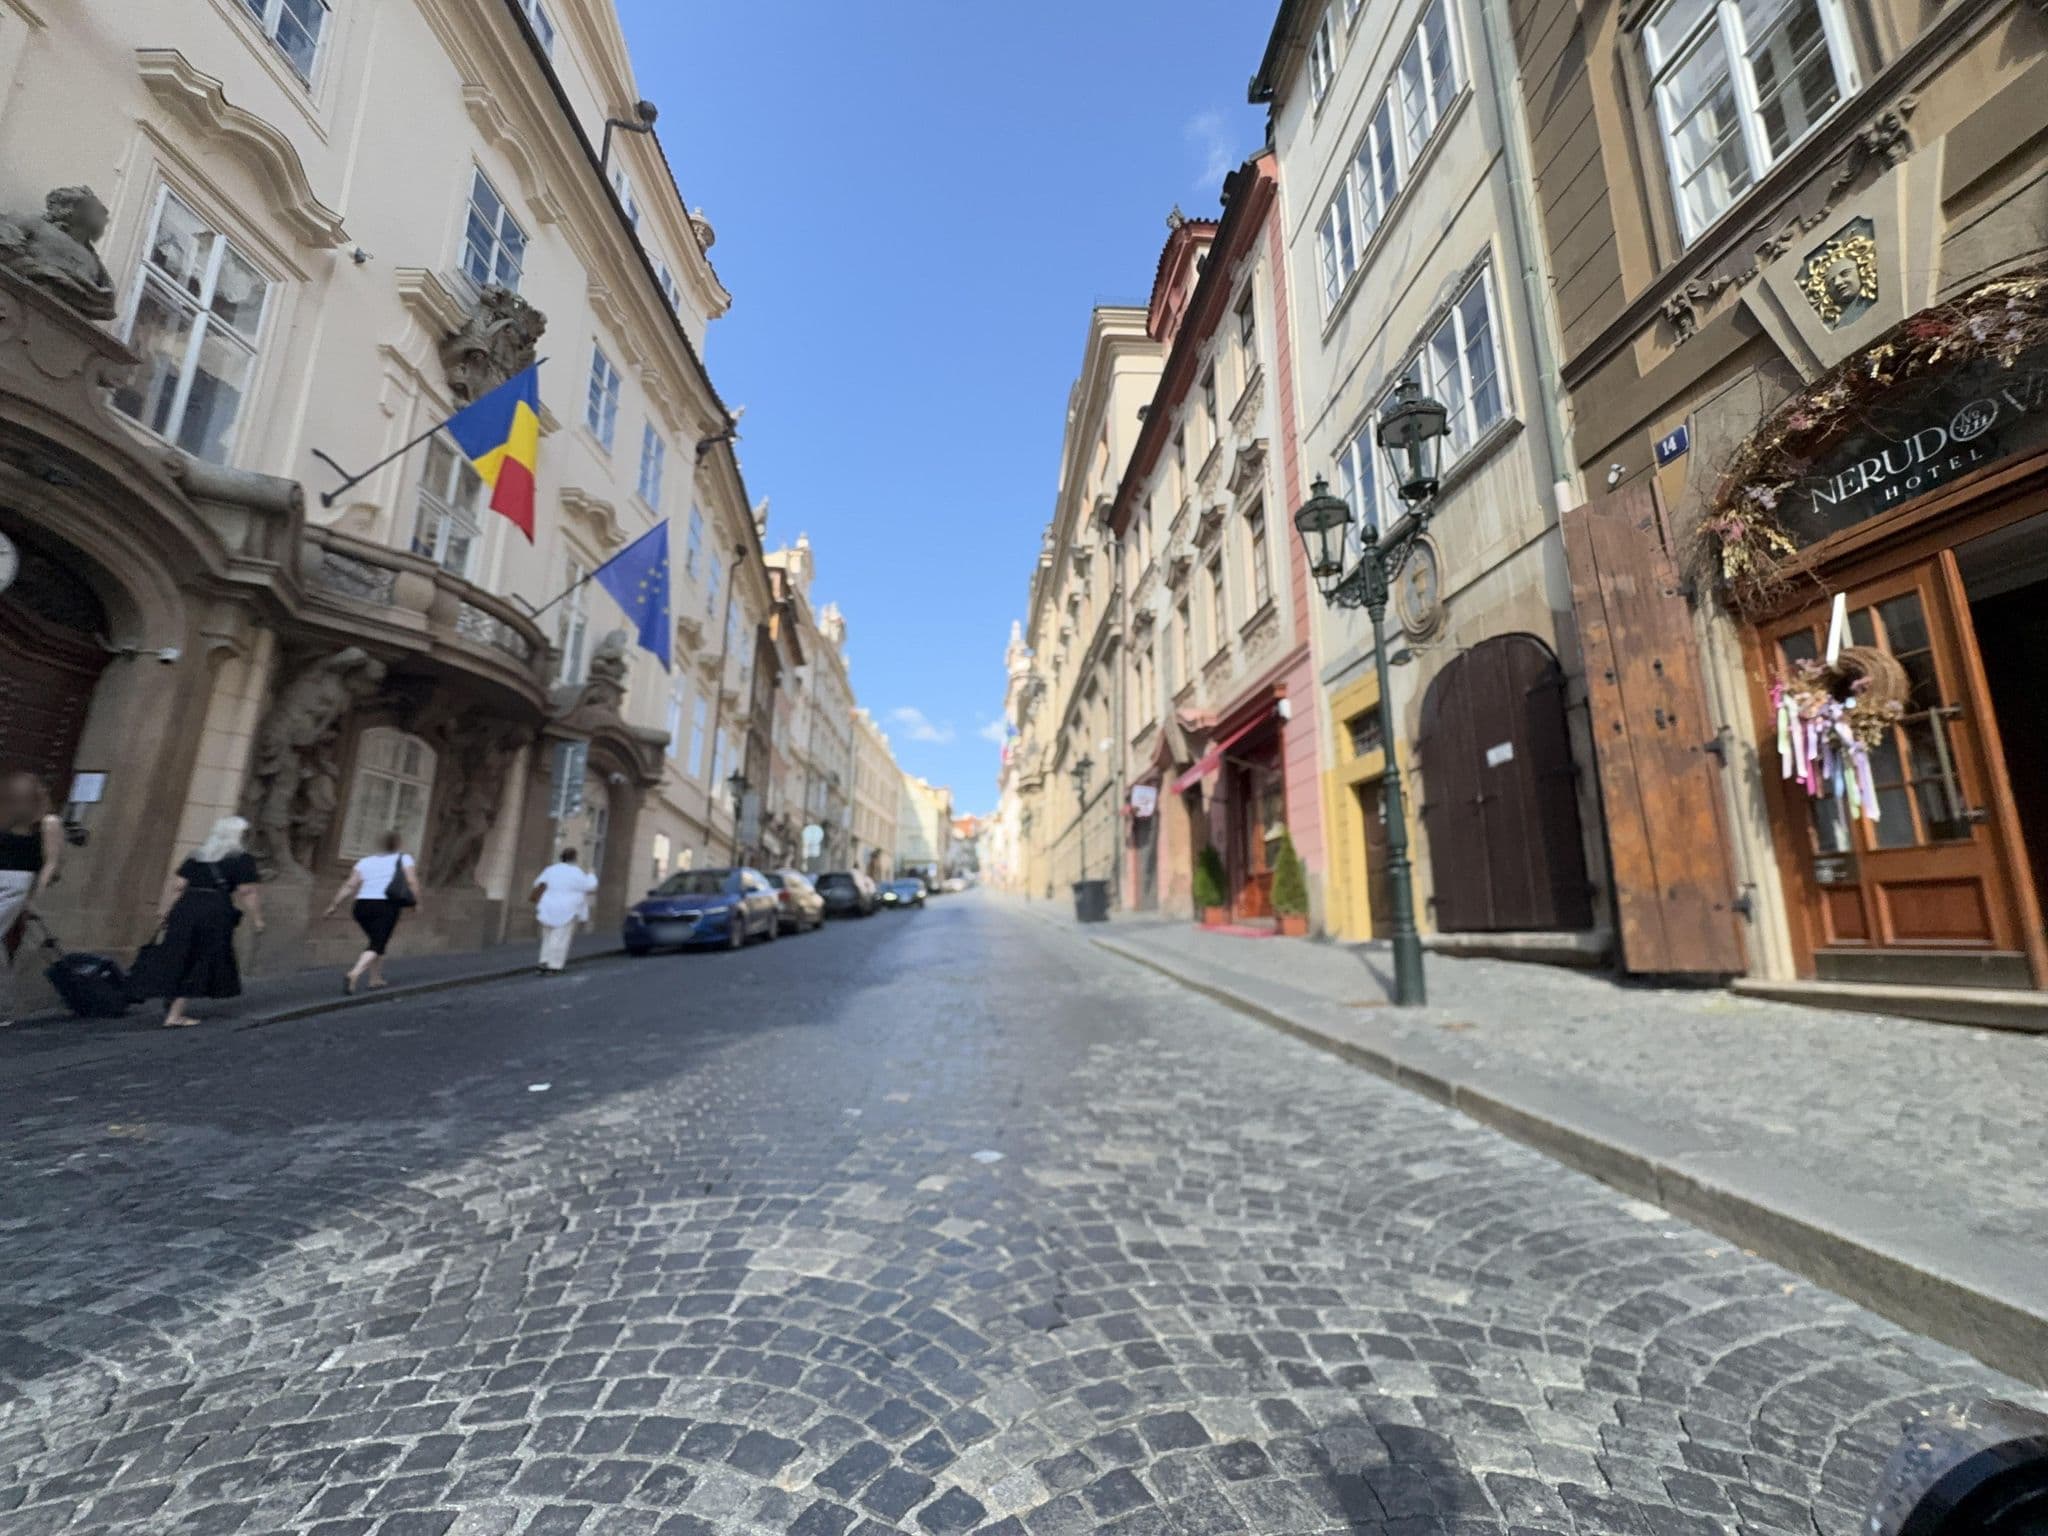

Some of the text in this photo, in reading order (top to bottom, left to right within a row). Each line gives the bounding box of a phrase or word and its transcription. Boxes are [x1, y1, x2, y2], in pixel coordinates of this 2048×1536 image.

[1662, 435, 1677, 456] 14
[1810, 368, 2048, 513] NERUDOV
[1885, 449, 1983, 500] HOTEL
